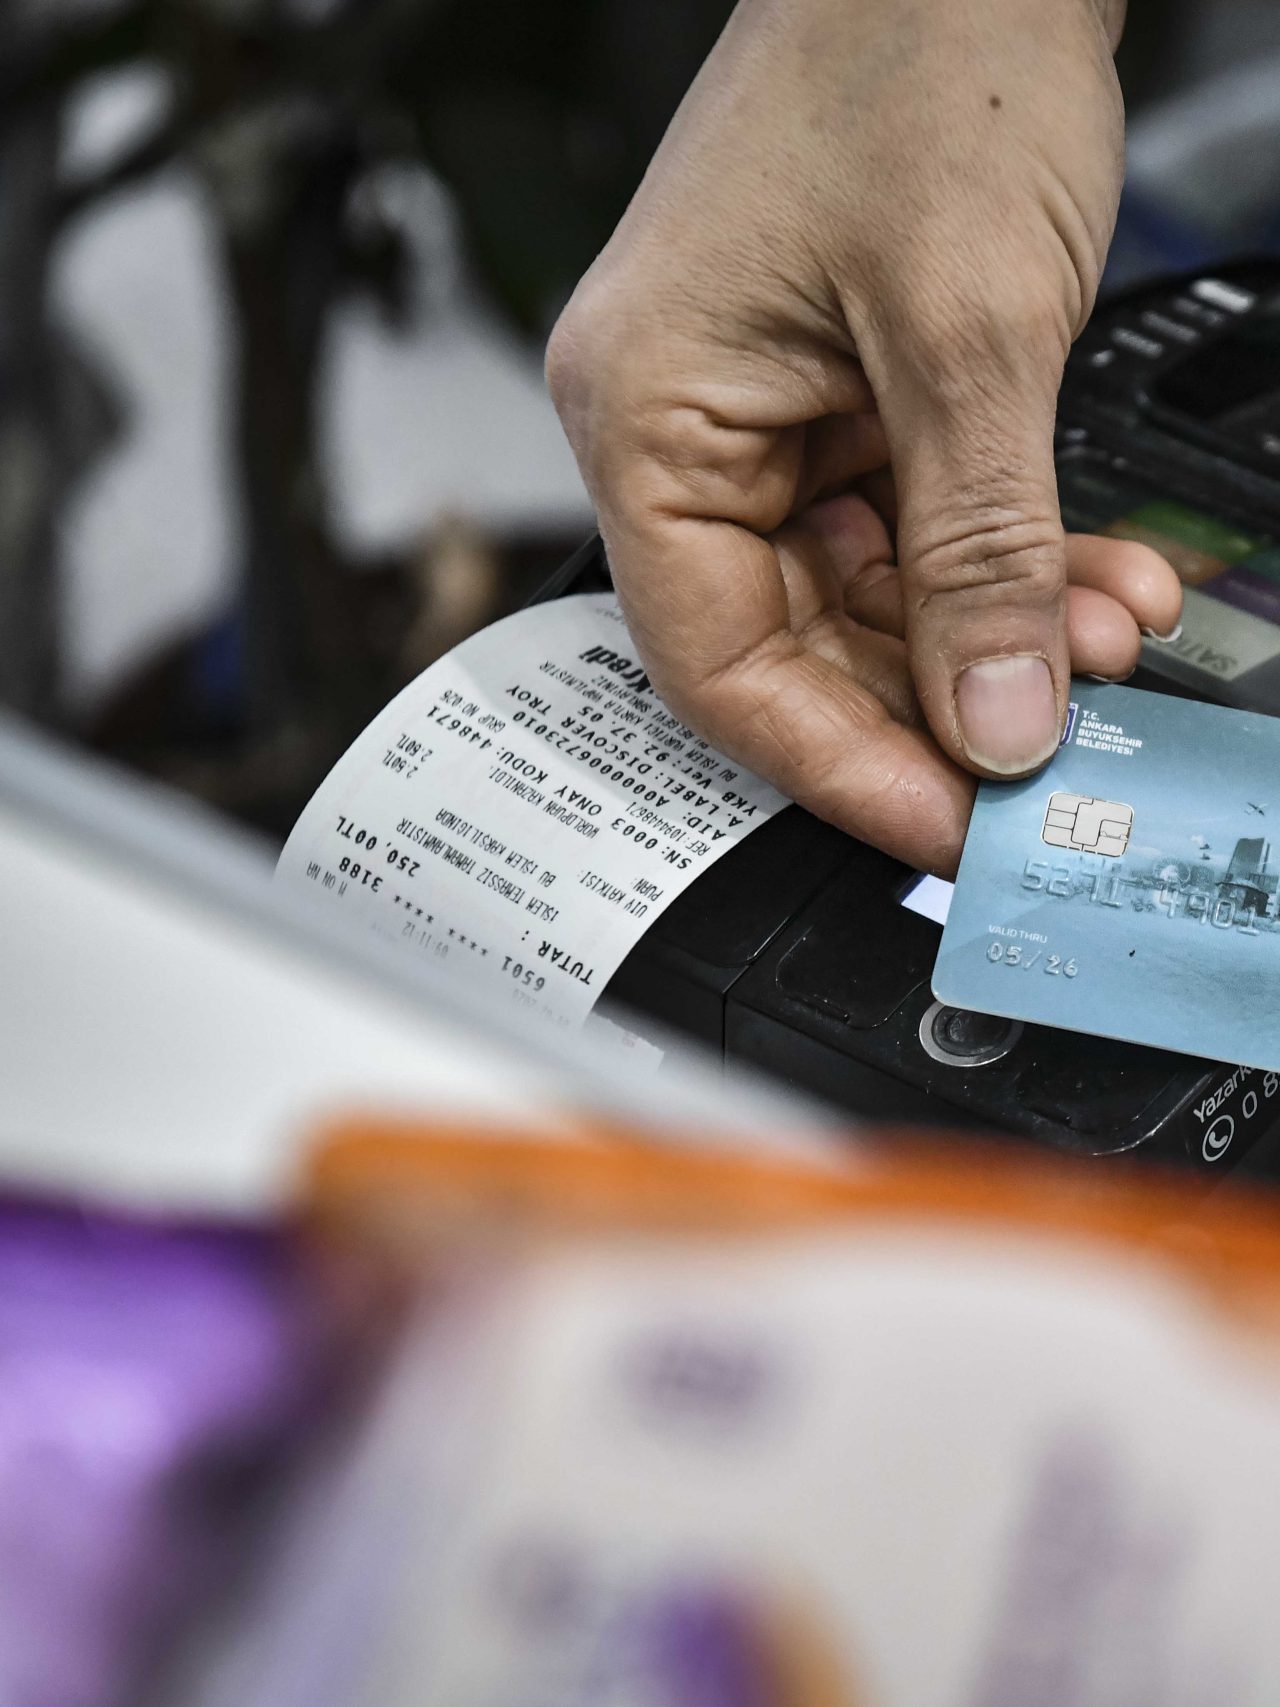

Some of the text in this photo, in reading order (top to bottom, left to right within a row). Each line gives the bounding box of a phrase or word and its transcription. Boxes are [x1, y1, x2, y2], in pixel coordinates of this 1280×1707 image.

[577, 644, 653, 694] Kredi
[505, 684, 551, 715] TROY
[1080, 719, 1123, 735] ANKARA
[1082, 710, 1100, 721] T.C.
[717, 767, 738, 782] BU
[553, 784, 601, 815] ONAY
[721, 788, 758, 816] YKB
[542, 799, 599, 838] WORLDPUAN
[682, 811, 726, 840] AID:
[338, 856, 382, 892] 3188
[475, 867, 525, 904] TEMASSIZ
[538, 870, 556, 887] BU
[1155, 883, 1266, 935] 4901
[987, 924, 1048, 944] VALID THRU
[501, 955, 545, 990] 6501
[537, 940, 593, 984] TUTAR
[986, 942, 1079, 978] 05/26
[1193, 1065, 1255, 1124] Yazark
[1242, 1090, 1257, 1119] 0
